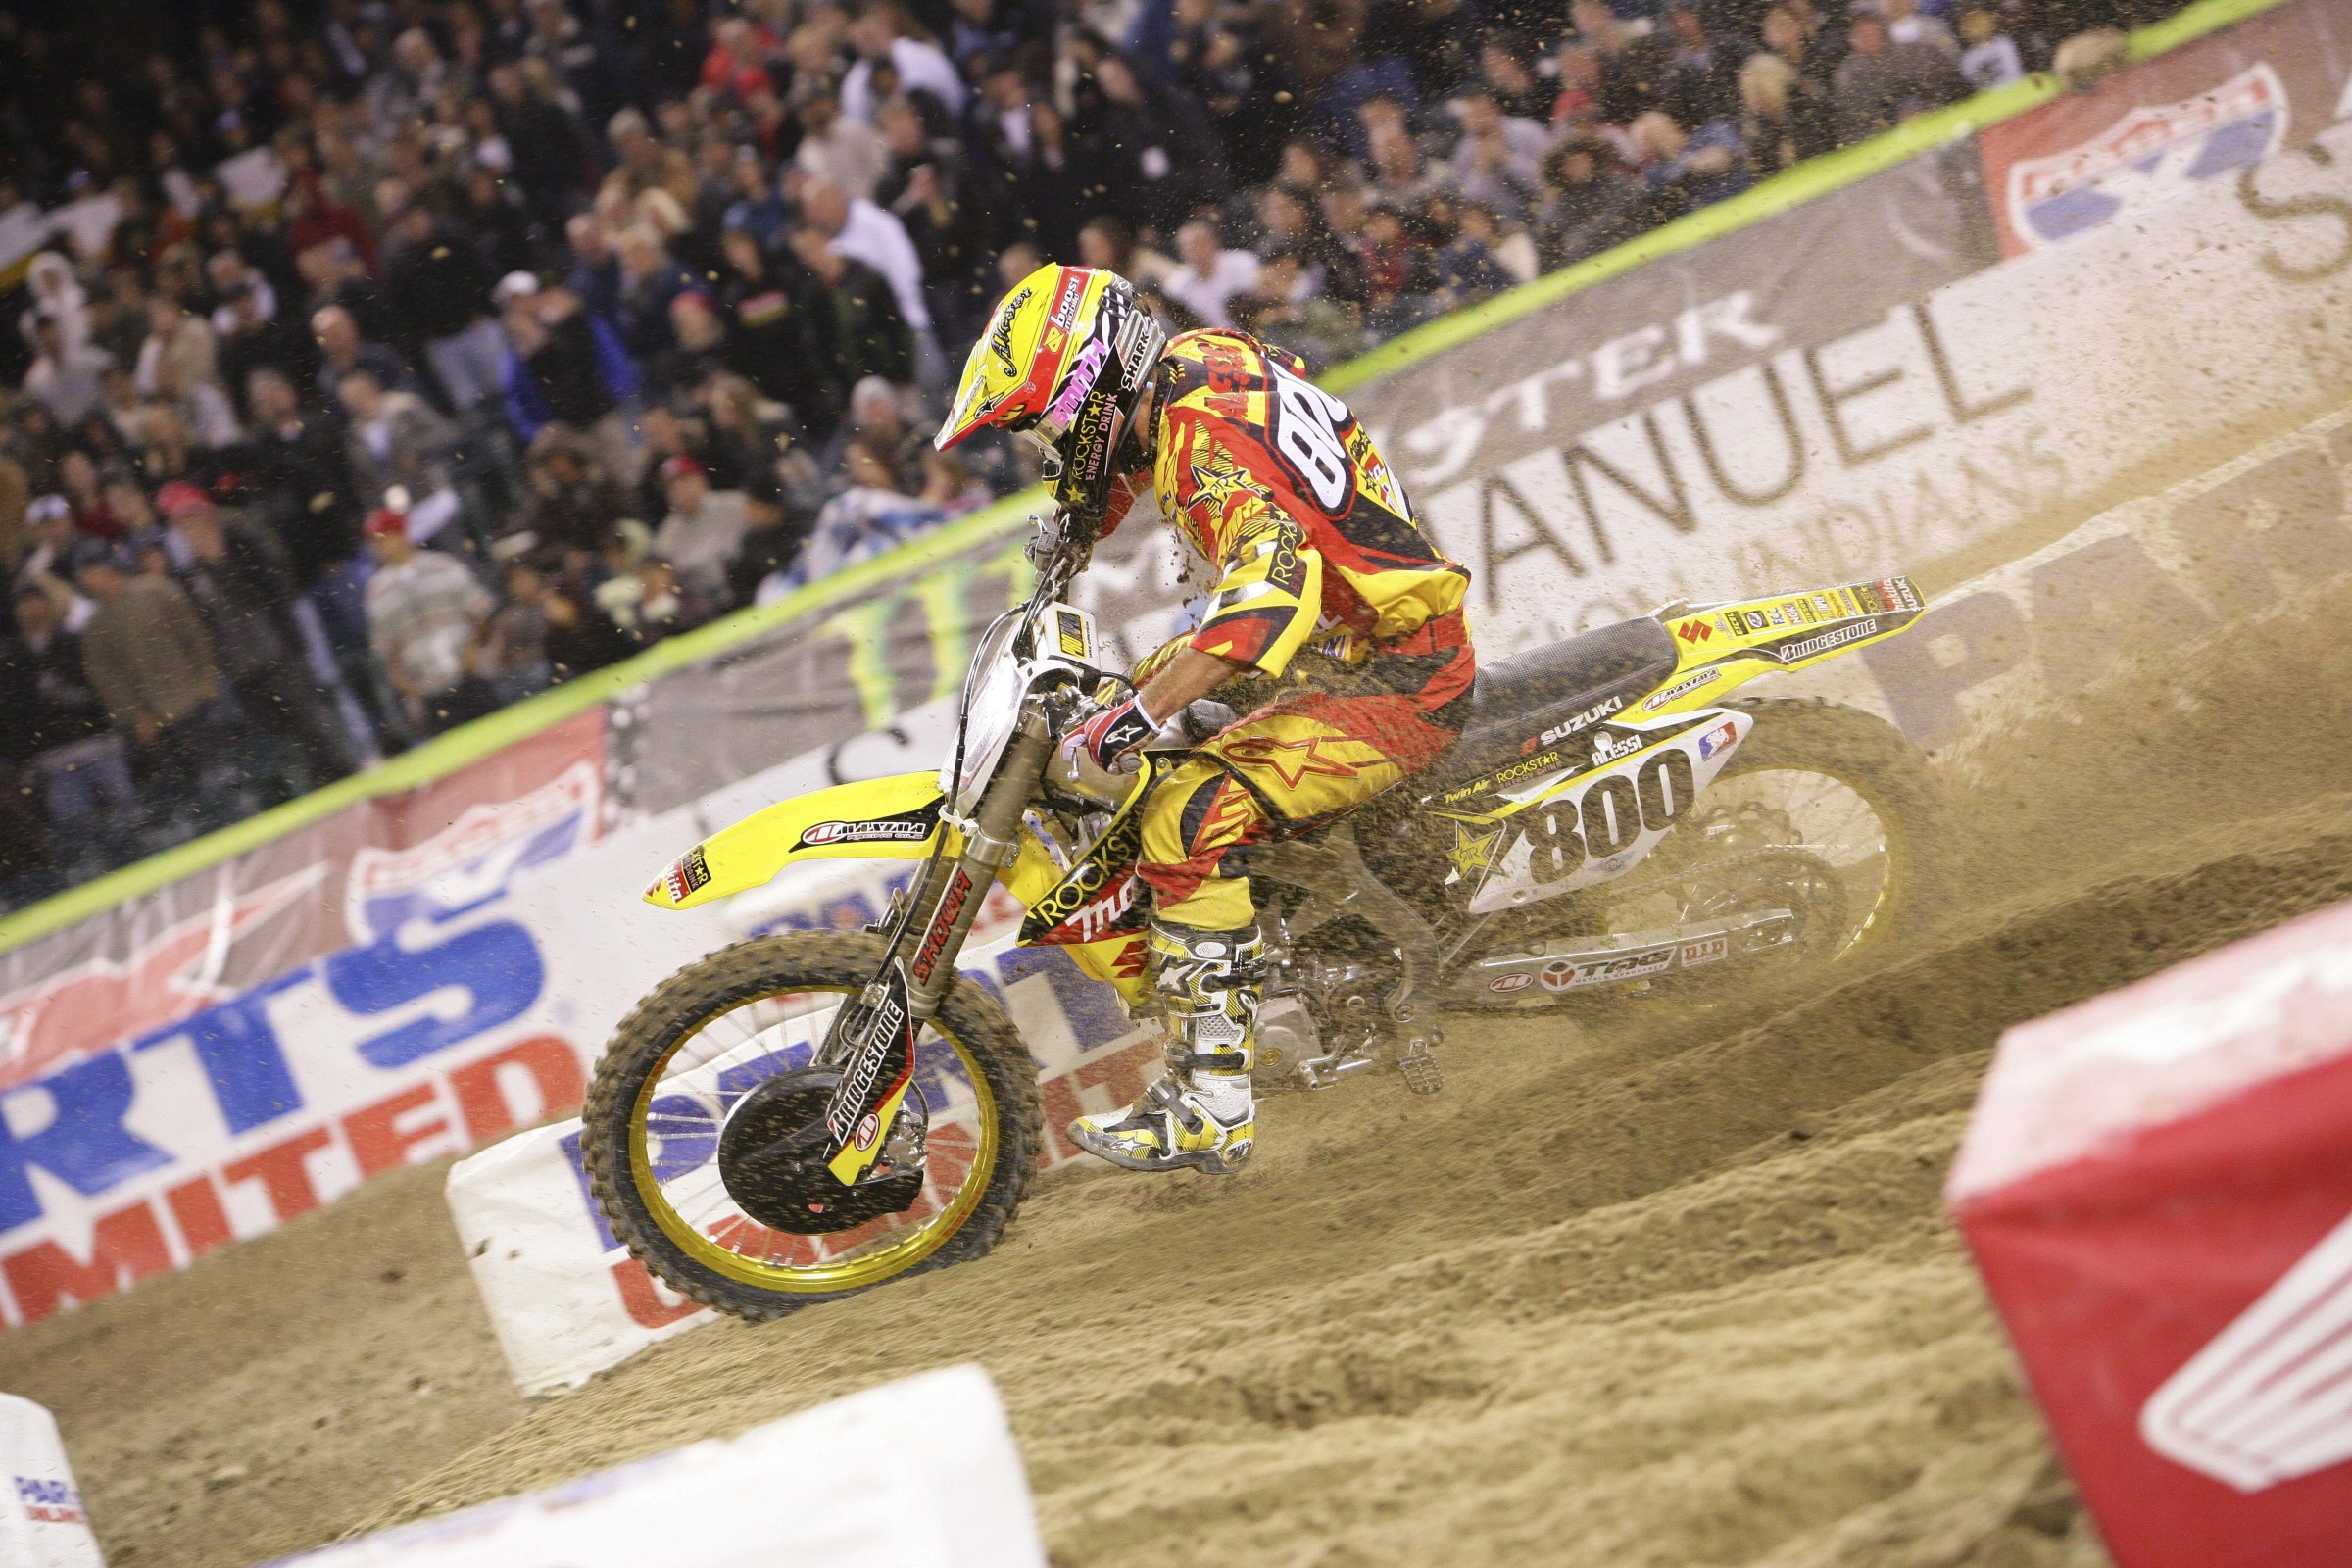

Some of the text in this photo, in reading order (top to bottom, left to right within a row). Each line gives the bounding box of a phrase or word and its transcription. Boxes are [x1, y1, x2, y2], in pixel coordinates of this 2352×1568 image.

[1050, 276, 1081, 328] boost
[1120, 331, 1151, 392] SHARK
[1085, 393, 1118, 482] ENERGY DRINK
[1478, 292, 2038, 610] ANUEL
[1728, 612, 1744, 636] EXCEL
[1780, 618, 1877, 660] BRIDGESTONE
[1540, 695, 1623, 747] SUZUKI
[1592, 734, 1643, 767] ALESSI
[1444, 779, 1491, 804] Twin Air
[1525, 749, 1696, 886] 800
[846, 832, 890, 842] RACING
[911, 867, 975, 986] SHOWA
[1577, 947, 1675, 977] TAG
[825, 999, 905, 1148] BRIDGESTONE
